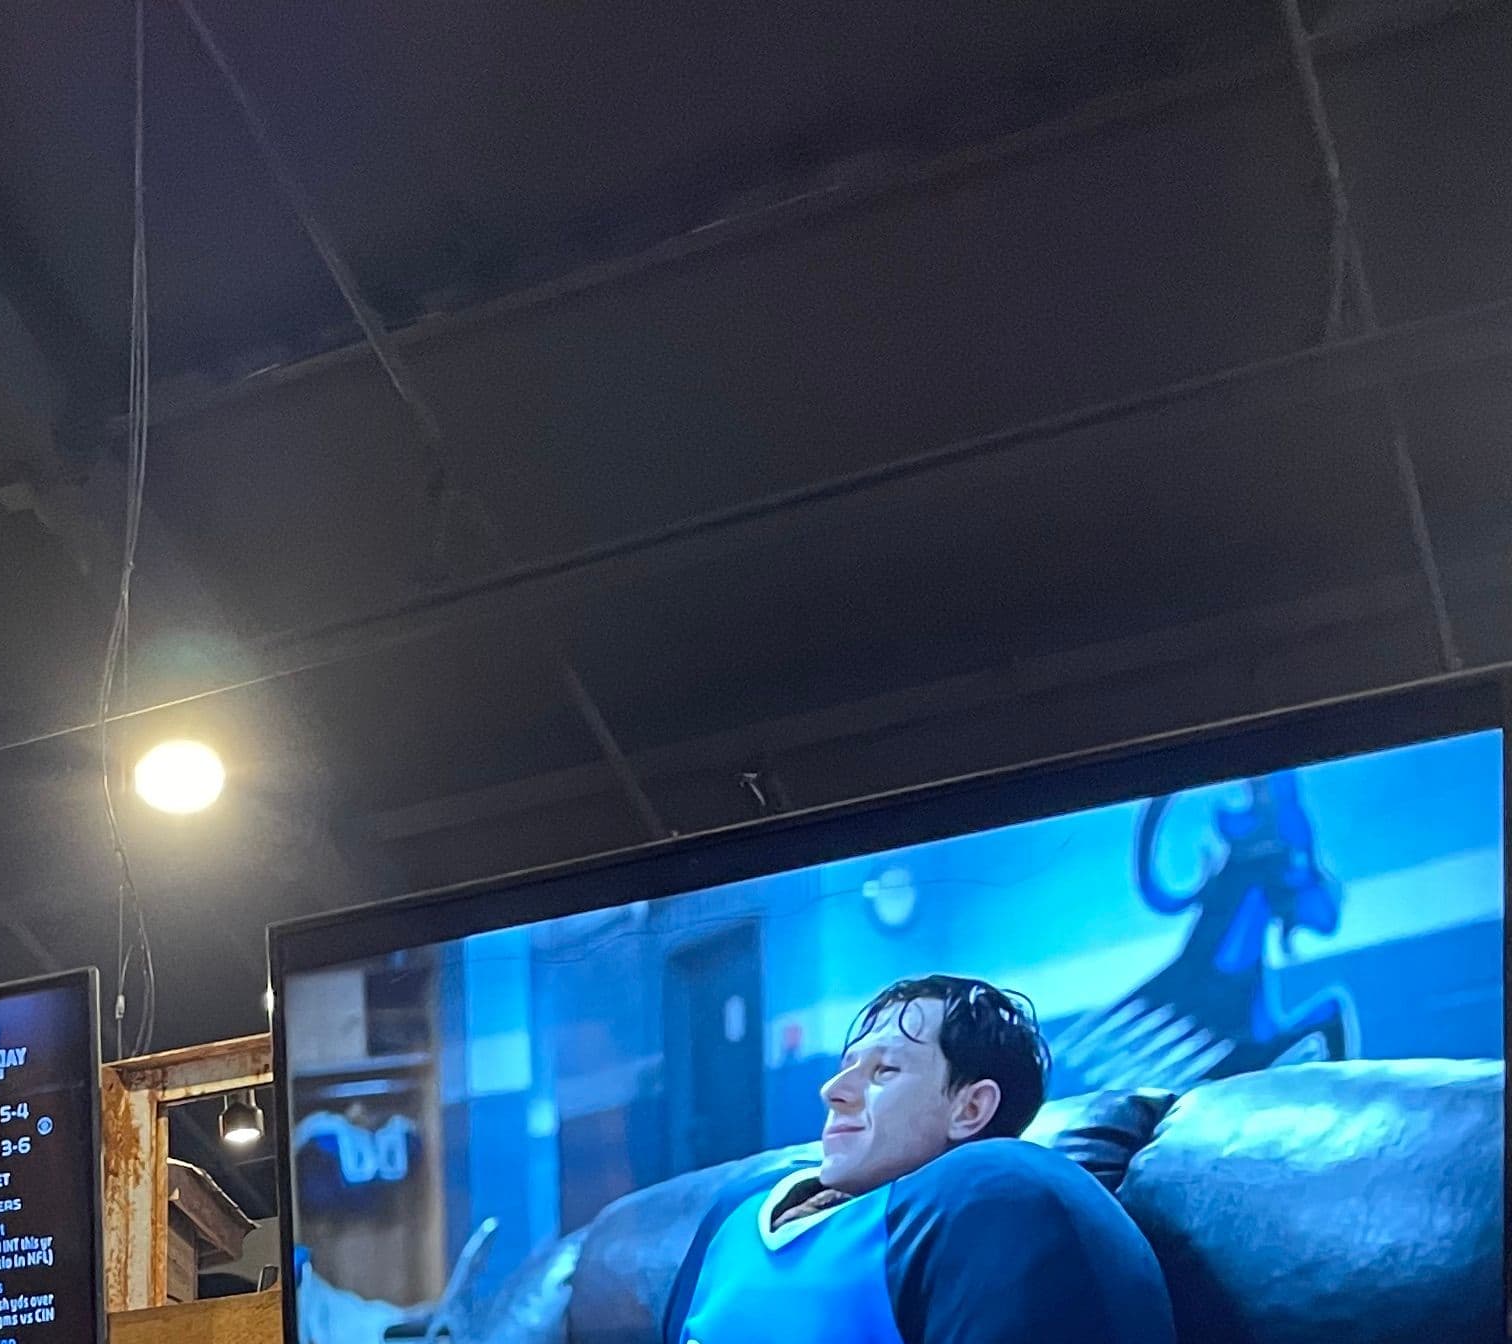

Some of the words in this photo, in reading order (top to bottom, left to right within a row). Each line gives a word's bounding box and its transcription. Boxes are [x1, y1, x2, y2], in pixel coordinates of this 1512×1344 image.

[0, 1103, 29, 1122] 5-4
[1, 1137, 31, 1157] 3-6
[27, 1248, 54, 1266] NFL)
[10, 1294, 29, 1312] yds
[30, 1294, 54, 1307] over
[20, 1312, 33, 1324] vs
[35, 1306, 55, 1322] CIN
